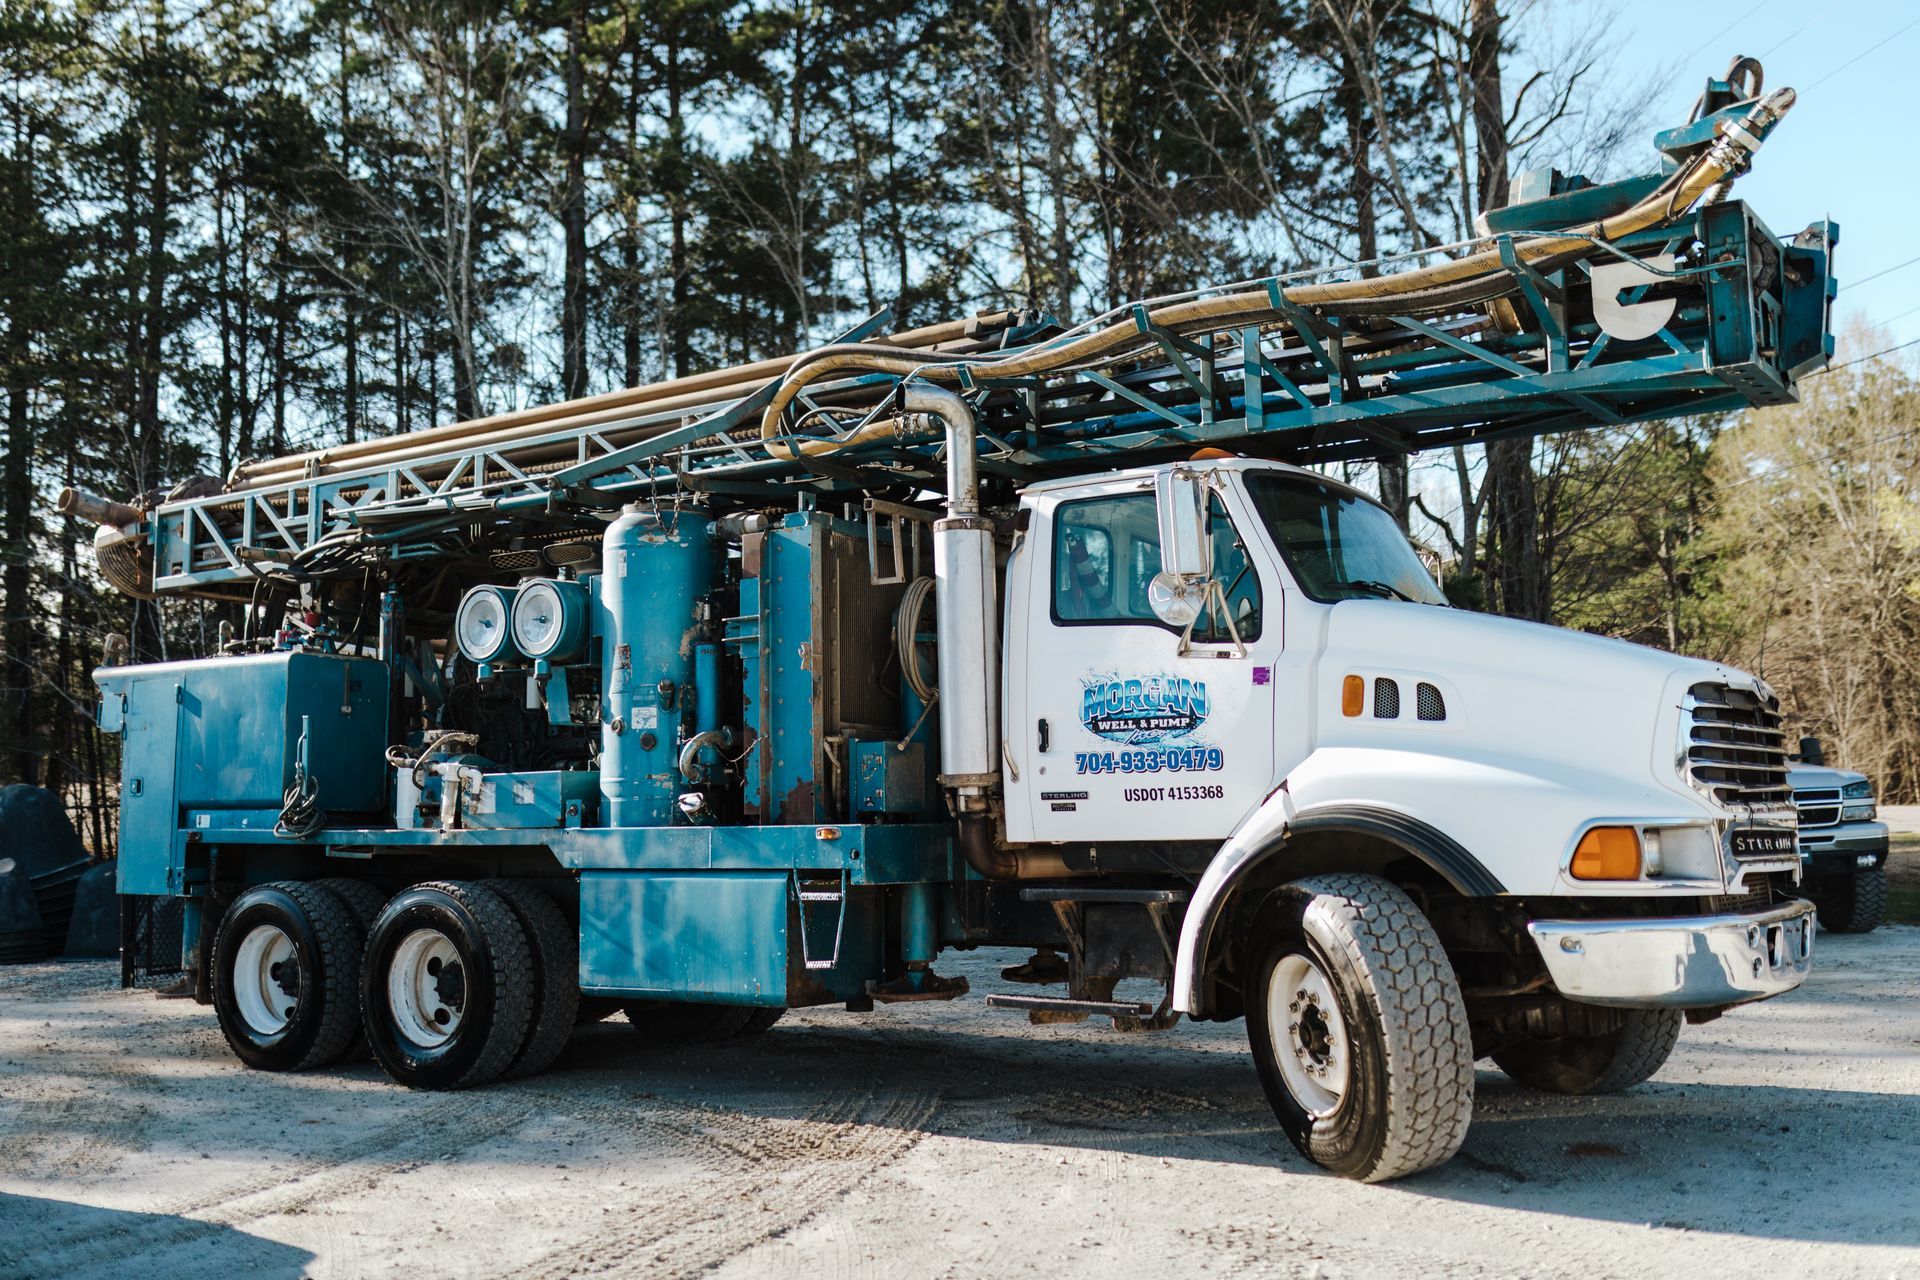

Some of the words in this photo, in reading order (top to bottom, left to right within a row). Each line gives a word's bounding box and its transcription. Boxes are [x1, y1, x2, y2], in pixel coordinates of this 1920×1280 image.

[1083, 677, 1207, 723] MORGAN
[1098, 720, 1136, 731] WELL
[1140, 719, 1148, 728] &
[1150, 718, 1190, 728] PUMP
[1075, 748, 1224, 774] 704-933-0479
[1124, 787, 1165, 802] USDOT
[1168, 785, 1224, 800] 4153368
